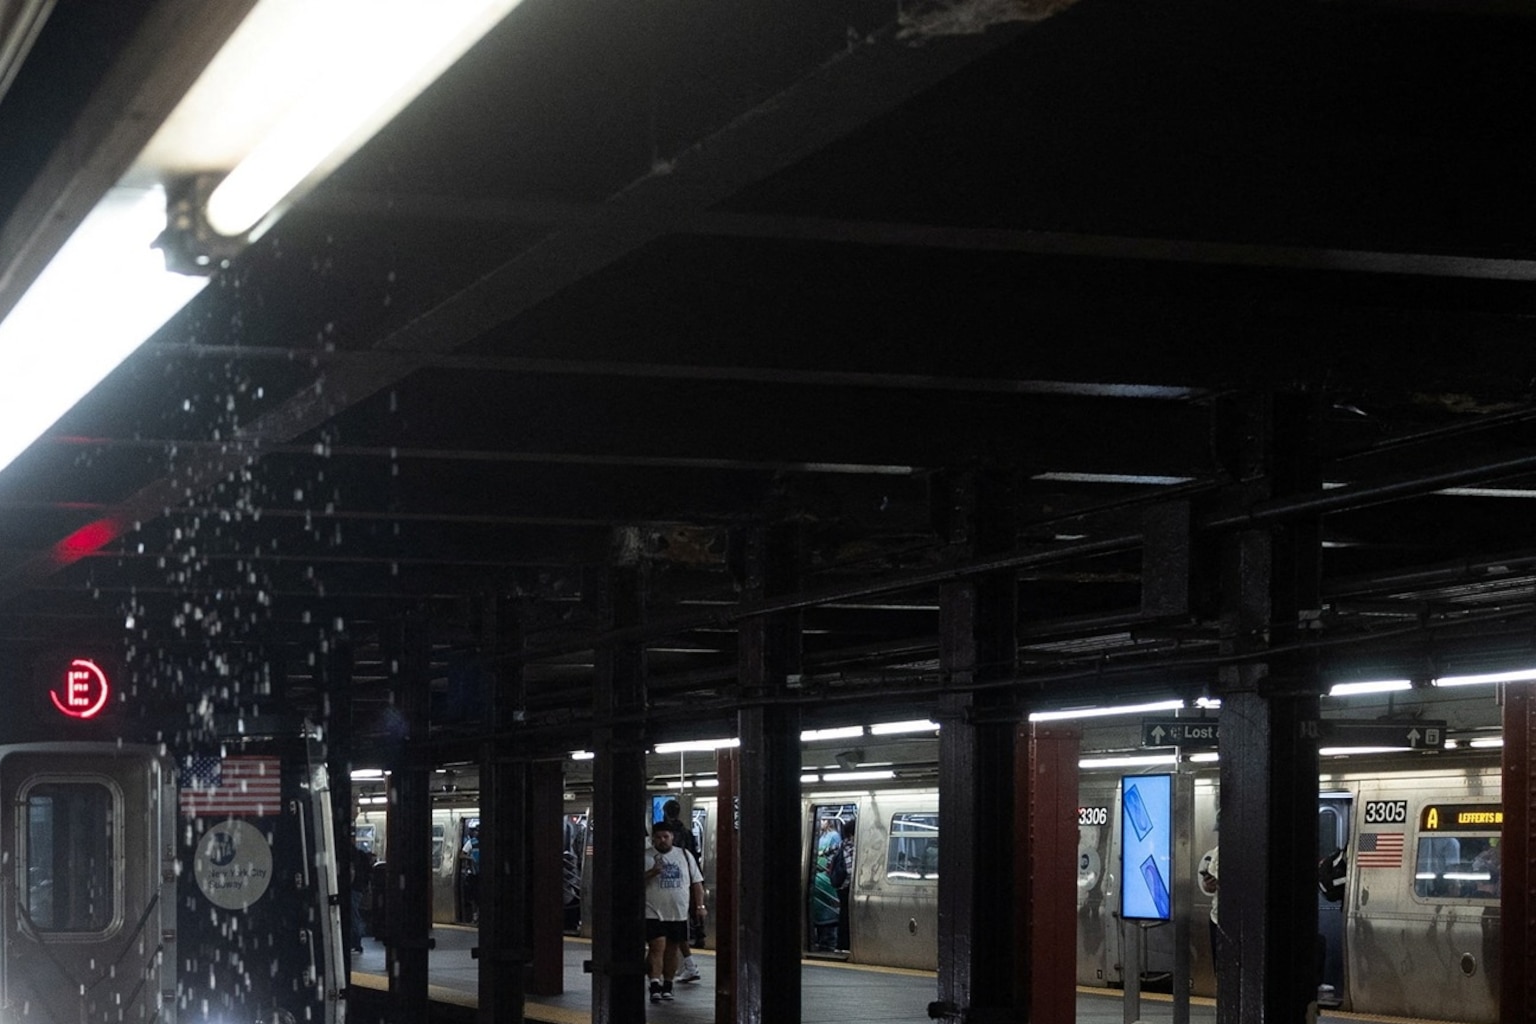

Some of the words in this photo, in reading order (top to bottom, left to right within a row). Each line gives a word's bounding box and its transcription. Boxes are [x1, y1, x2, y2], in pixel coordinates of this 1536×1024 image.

[68, 671, 89, 706] E
[1184, 725, 1213, 739] Lost
[1078, 807, 1107, 825] 3306
[1366, 802, 1406, 822] 3305
[1427, 808, 1439, 829] A
[1458, 812, 1494, 824] LEFFERTS
